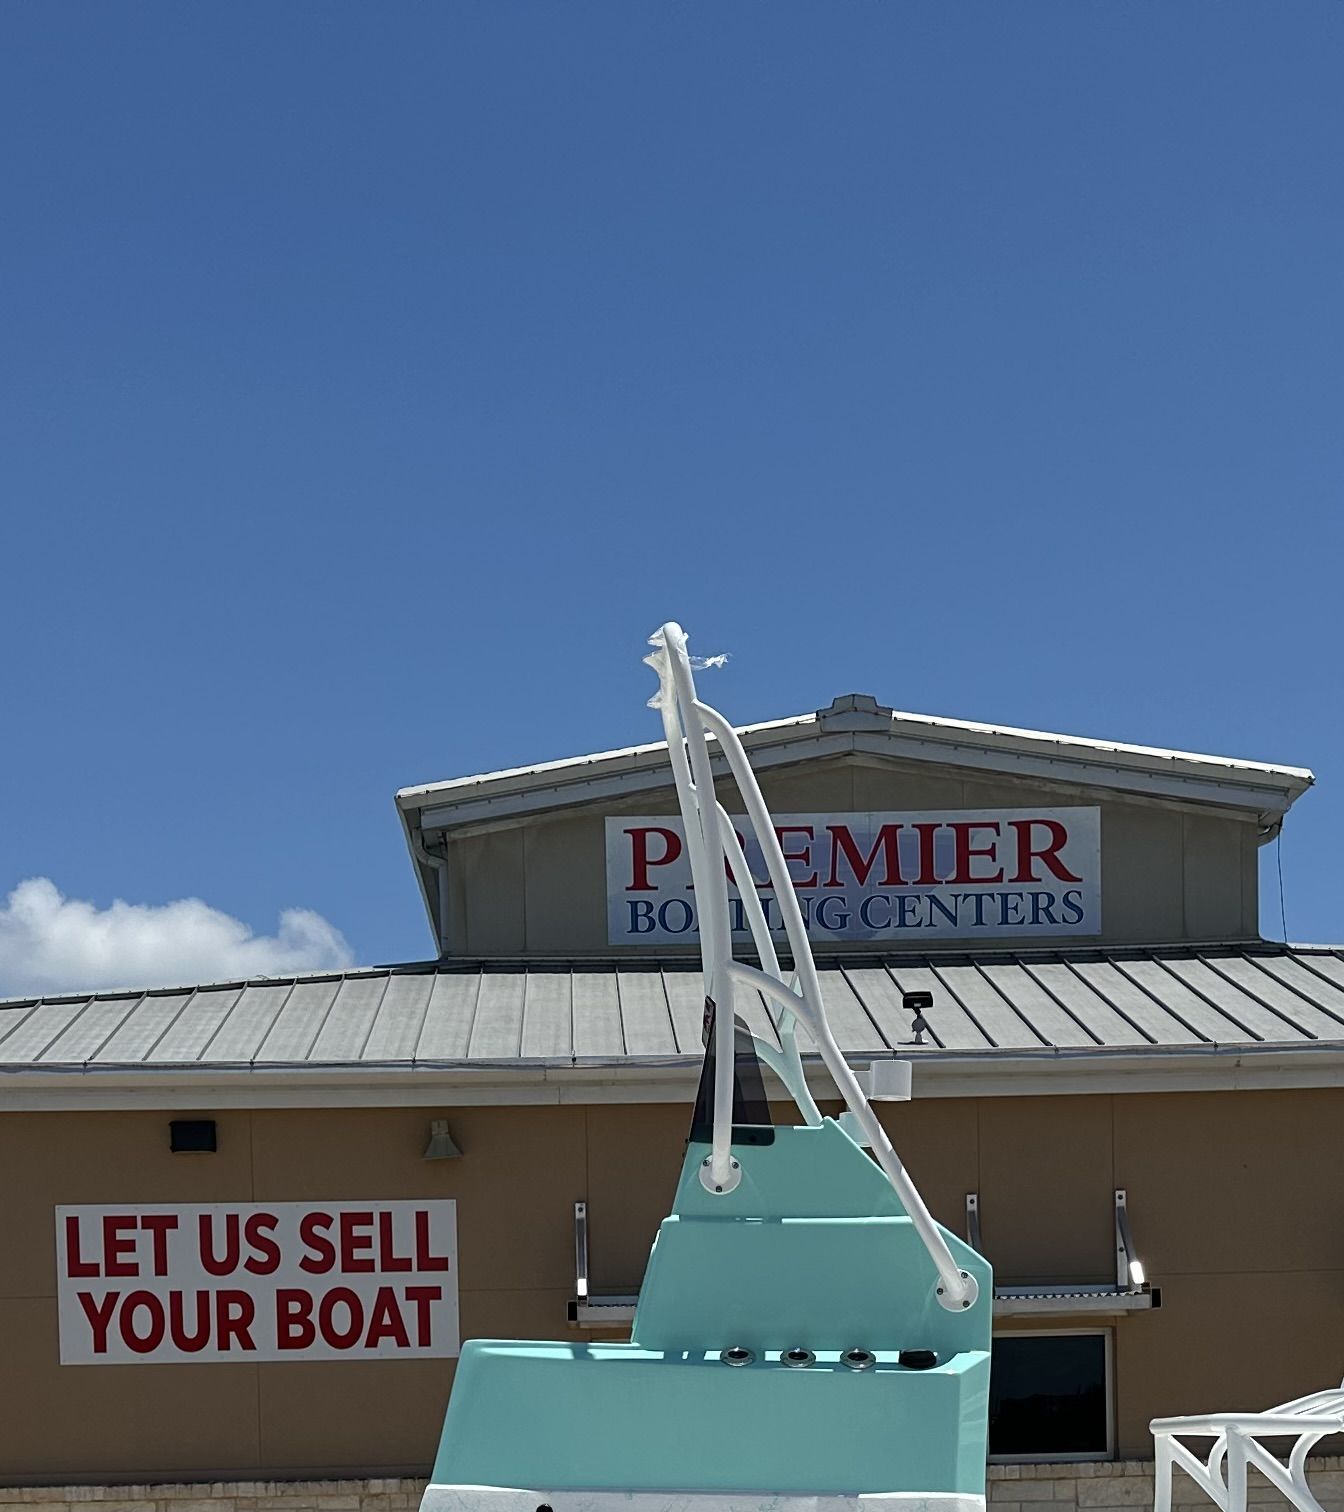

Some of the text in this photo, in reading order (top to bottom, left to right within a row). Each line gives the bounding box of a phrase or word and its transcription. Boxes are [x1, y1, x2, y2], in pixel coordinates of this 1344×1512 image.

[623, 819, 1083, 892] PEMIER
[859, 889, 1085, 931] CENTERS
[65, 1210, 449, 1278] LET US SELL
[76, 1286, 442, 1354] YOUR BOAT
